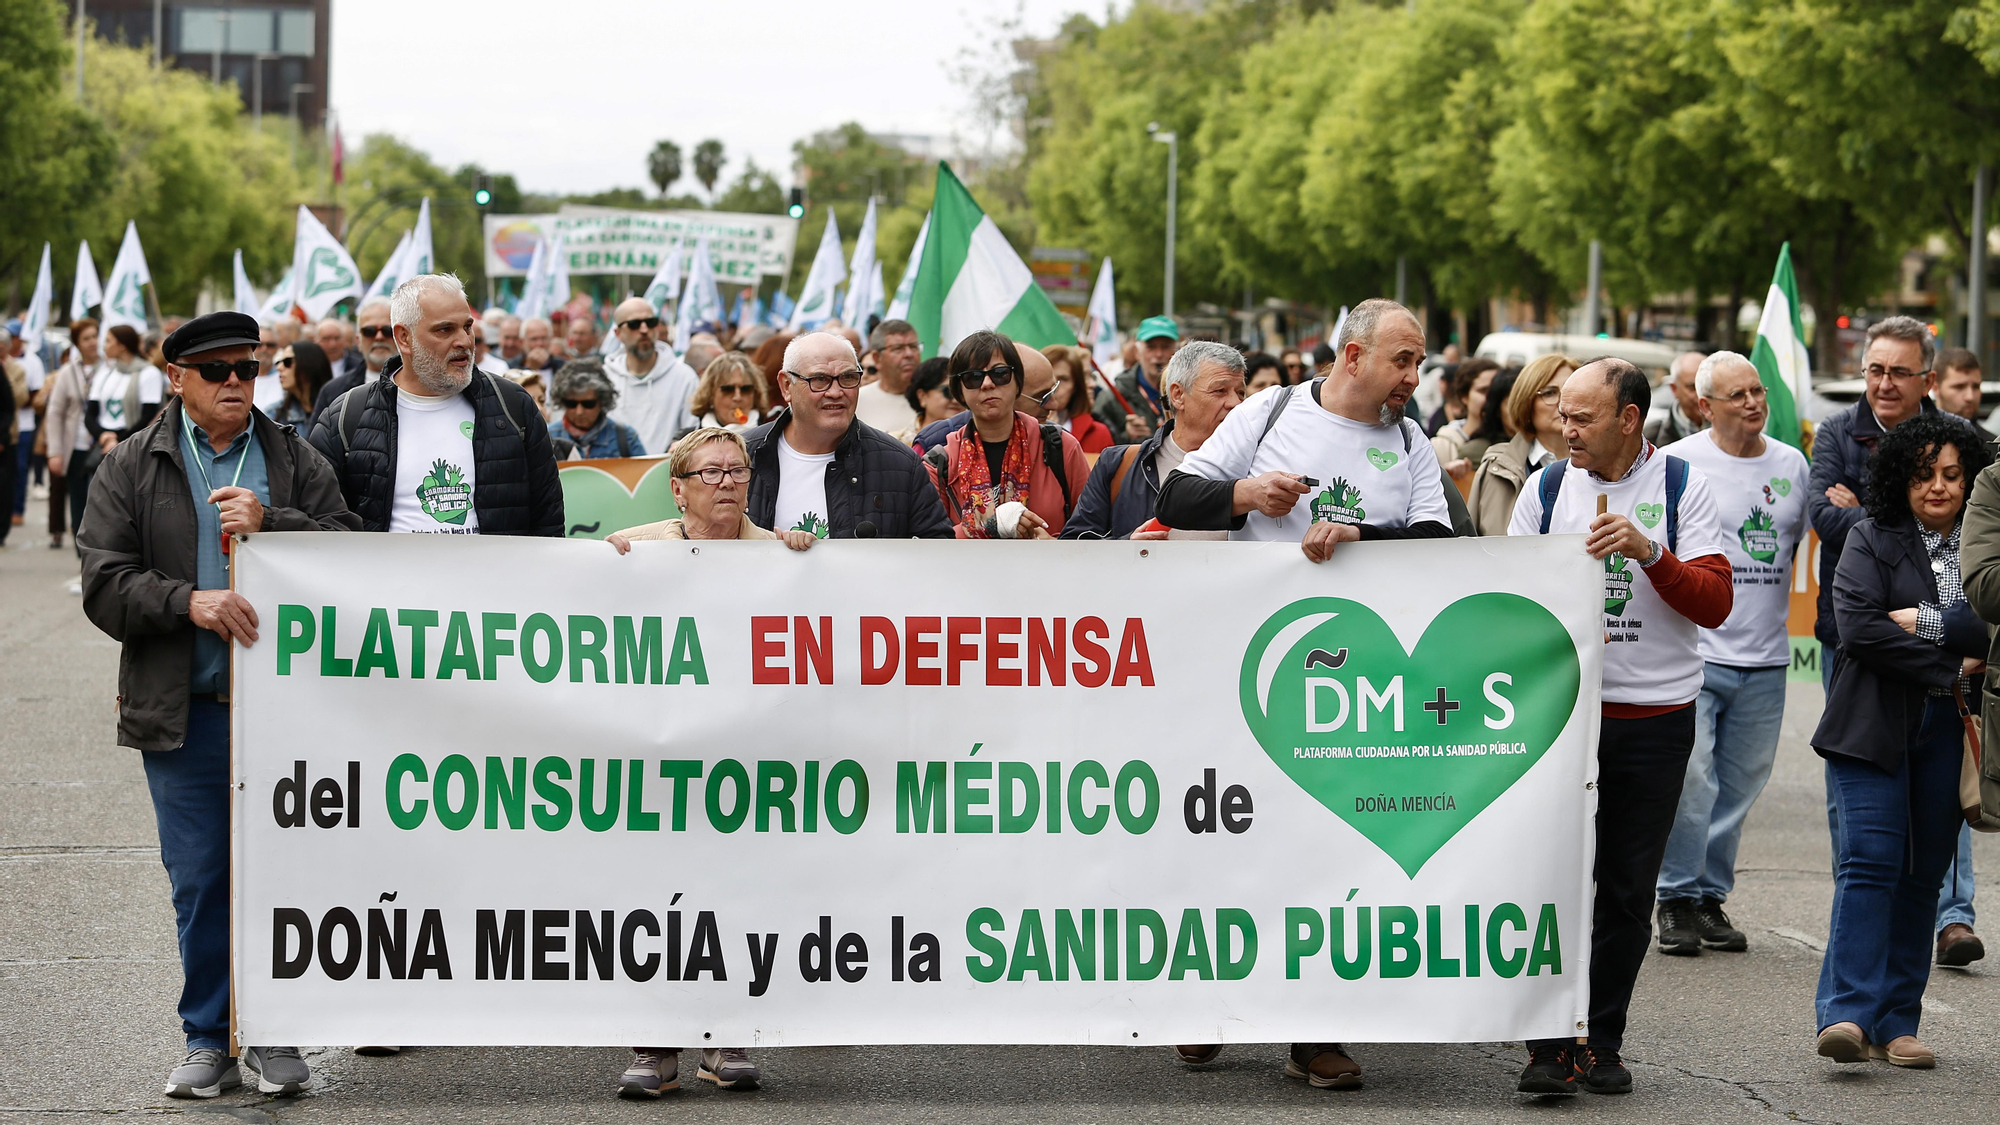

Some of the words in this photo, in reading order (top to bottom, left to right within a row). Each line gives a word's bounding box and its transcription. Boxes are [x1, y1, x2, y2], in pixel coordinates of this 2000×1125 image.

[569, 247, 658, 269] ERNÁN
[1317, 504, 1358, 517] ENAMORATE
[1606, 572, 1626, 581] ORATE
[274, 604, 709, 688] PLATAFORMA
[751, 615, 835, 686] EN
[859, 616, 1156, 689] DEFENSA
[1482, 671, 1516, 730] S
[1294, 747, 1353, 759] PLATAFORMA
[1355, 746, 1410, 758] CIUDADANA
[1412, 745, 1430, 757] POR
[1432, 745, 1444, 757] LA
[1446, 743, 1487, 756] SANIDAD
[1489, 741, 1527, 755] PÚBLICA
[273, 760, 361, 830] del
[385, 753, 869, 836] CONSULTORIO
[896, 743, 1160, 836] MÉDICO
[1183, 768, 1254, 836] de
[1355, 793, 1397, 813] DOÑA
[1401, 792, 1456, 812] MENCÍA
[272, 891, 453, 982] DOÑA
[475, 892, 729, 983] MENCÍA
[745, 932, 779, 998] y
[798, 915, 869, 984] de
[891, 915, 943, 984] la
[965, 907, 1259, 983] SANIDAD
[1284, 888, 1562, 981] PÚBLICA
